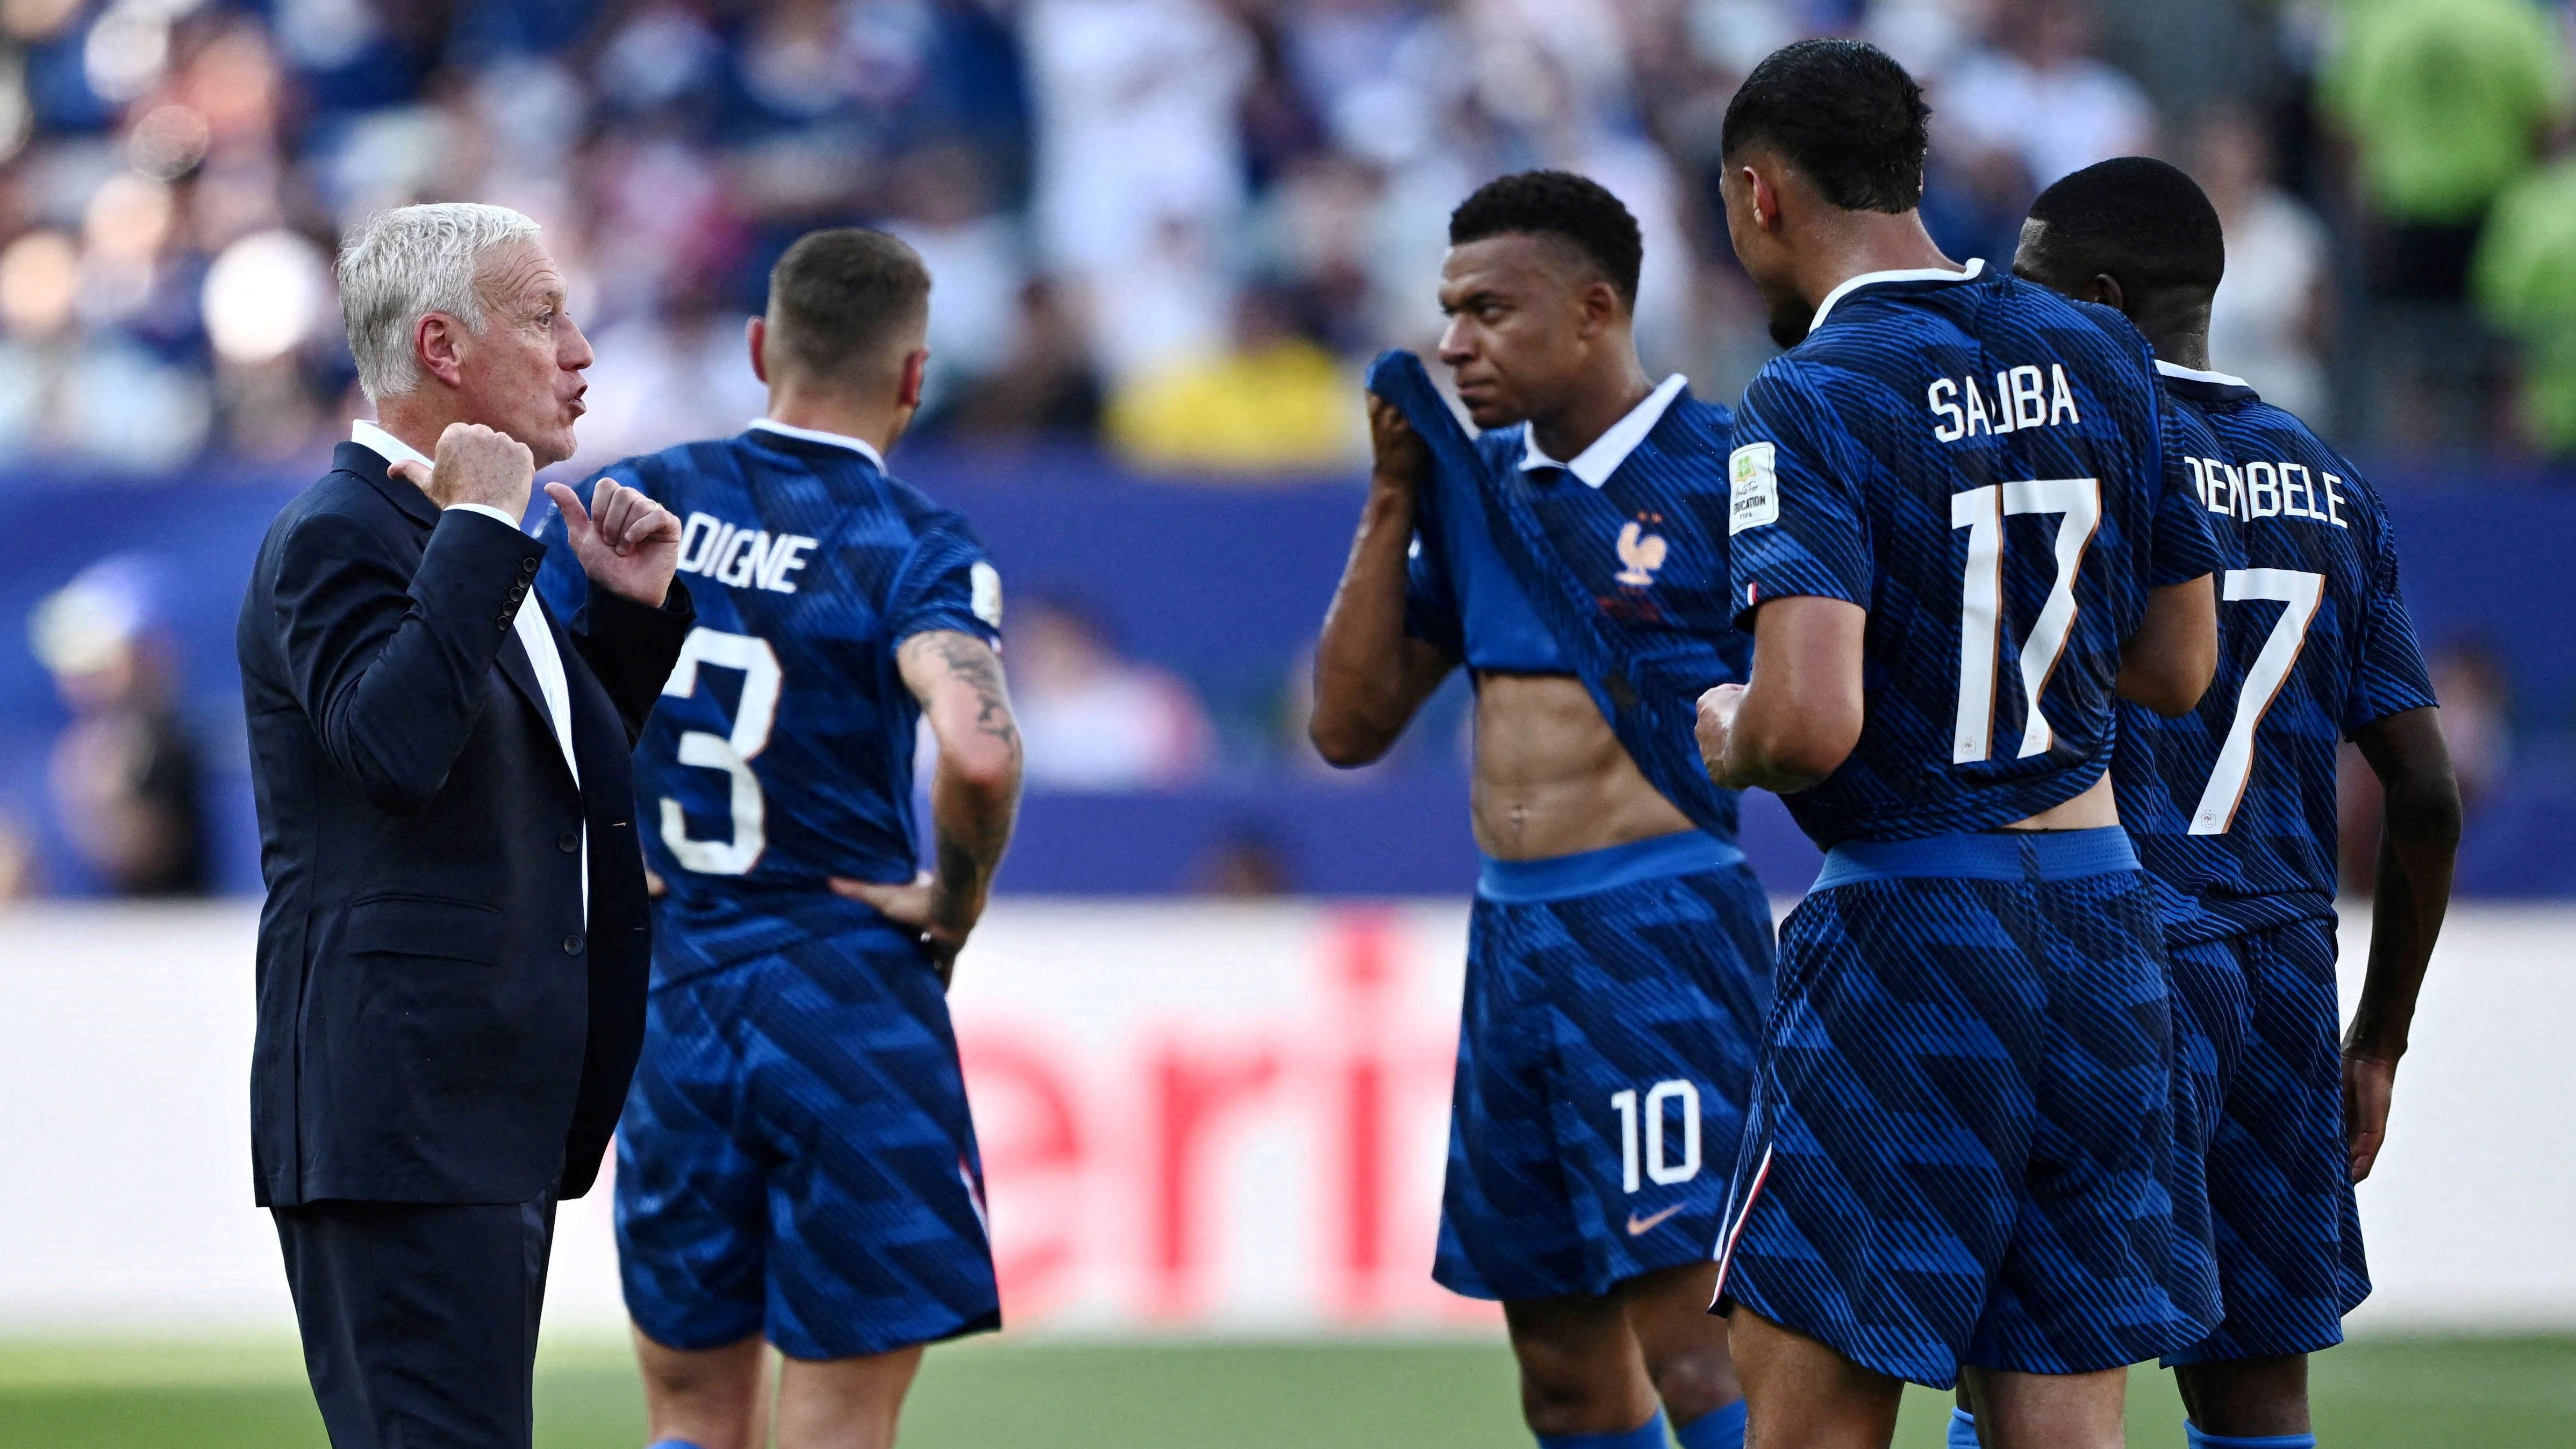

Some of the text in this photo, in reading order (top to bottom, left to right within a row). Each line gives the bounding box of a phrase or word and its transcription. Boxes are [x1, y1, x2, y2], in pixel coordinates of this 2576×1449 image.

[677, 511, 820, 595] DIGNE
[1734, 495, 1765, 515] EDUCATION
[1951, 477, 2103, 765] 17
[2187, 568, 2326, 836] 7
[659, 626, 785, 876] 3
[1611, 1078, 1703, 1194] 10
